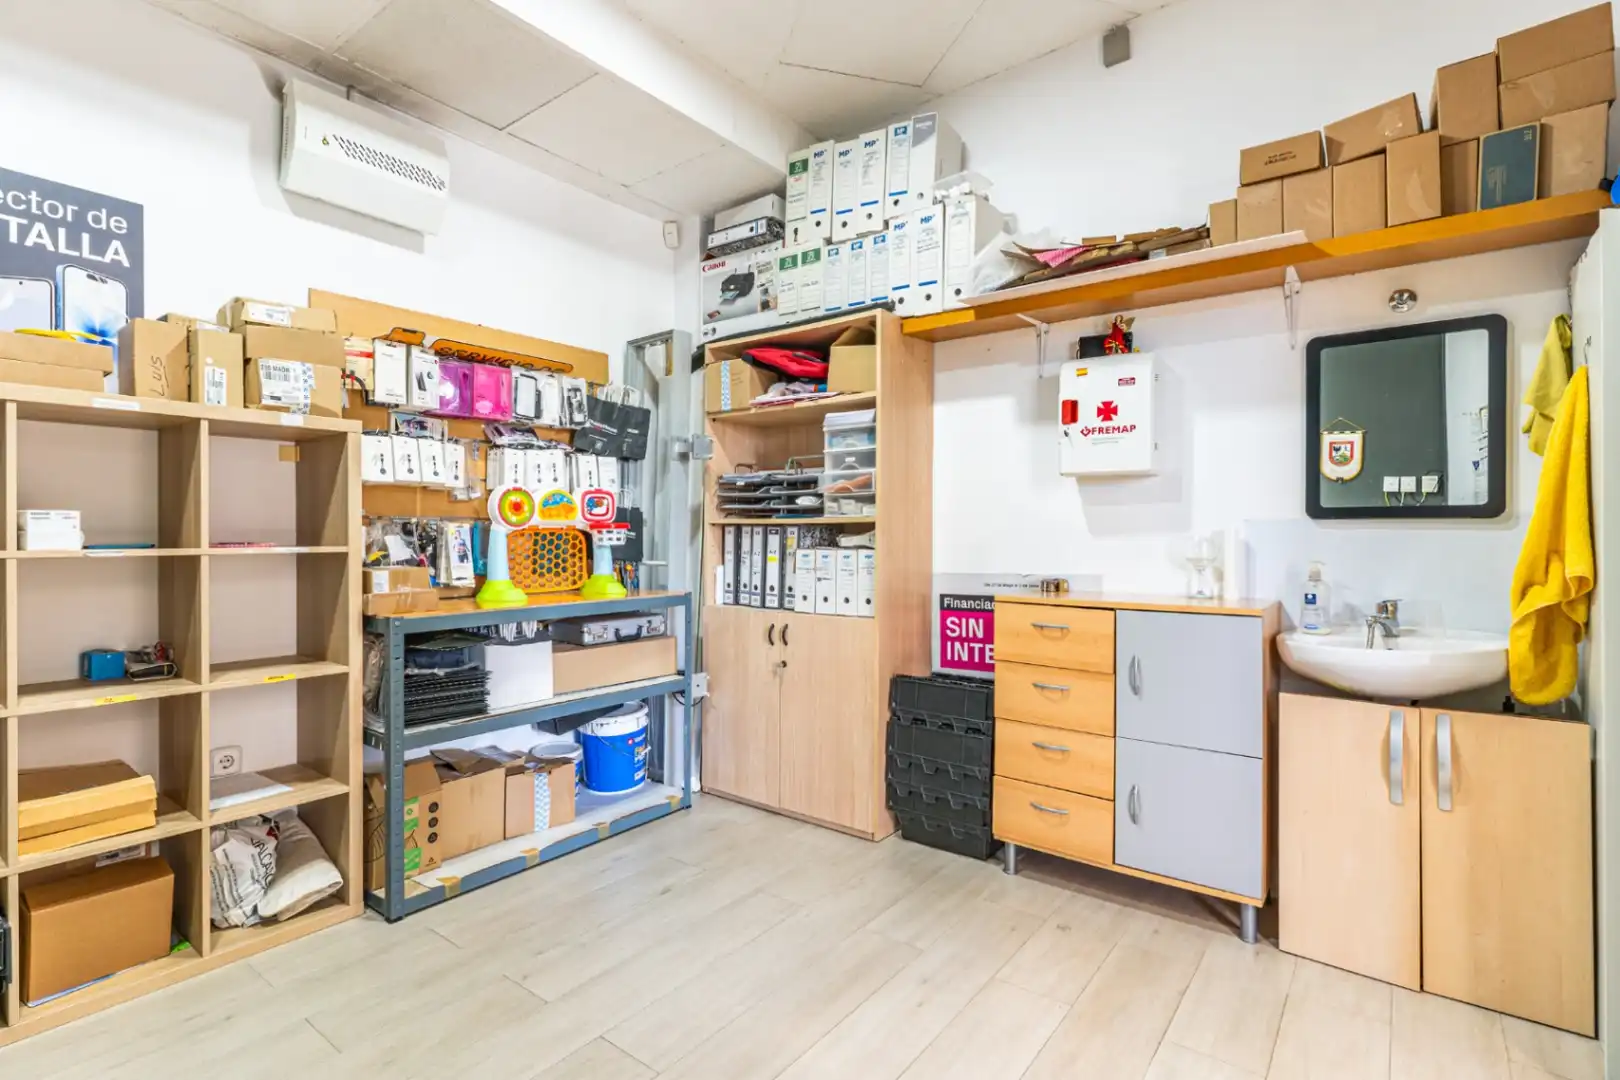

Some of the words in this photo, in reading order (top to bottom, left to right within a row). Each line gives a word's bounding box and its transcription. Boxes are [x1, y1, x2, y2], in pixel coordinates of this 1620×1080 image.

[864, 140, 876, 148] MP
[813, 151, 825, 159] MP
[839, 150, 850, 158] MP
[0, 188, 79, 223] ctor
[87, 208, 128, 234] de
[0, 213, 130, 268] TALLA
[1091, 424, 1137, 435] FREMAP
[946, 616, 984, 639] SIN
[947, 640, 995, 664] INTE
